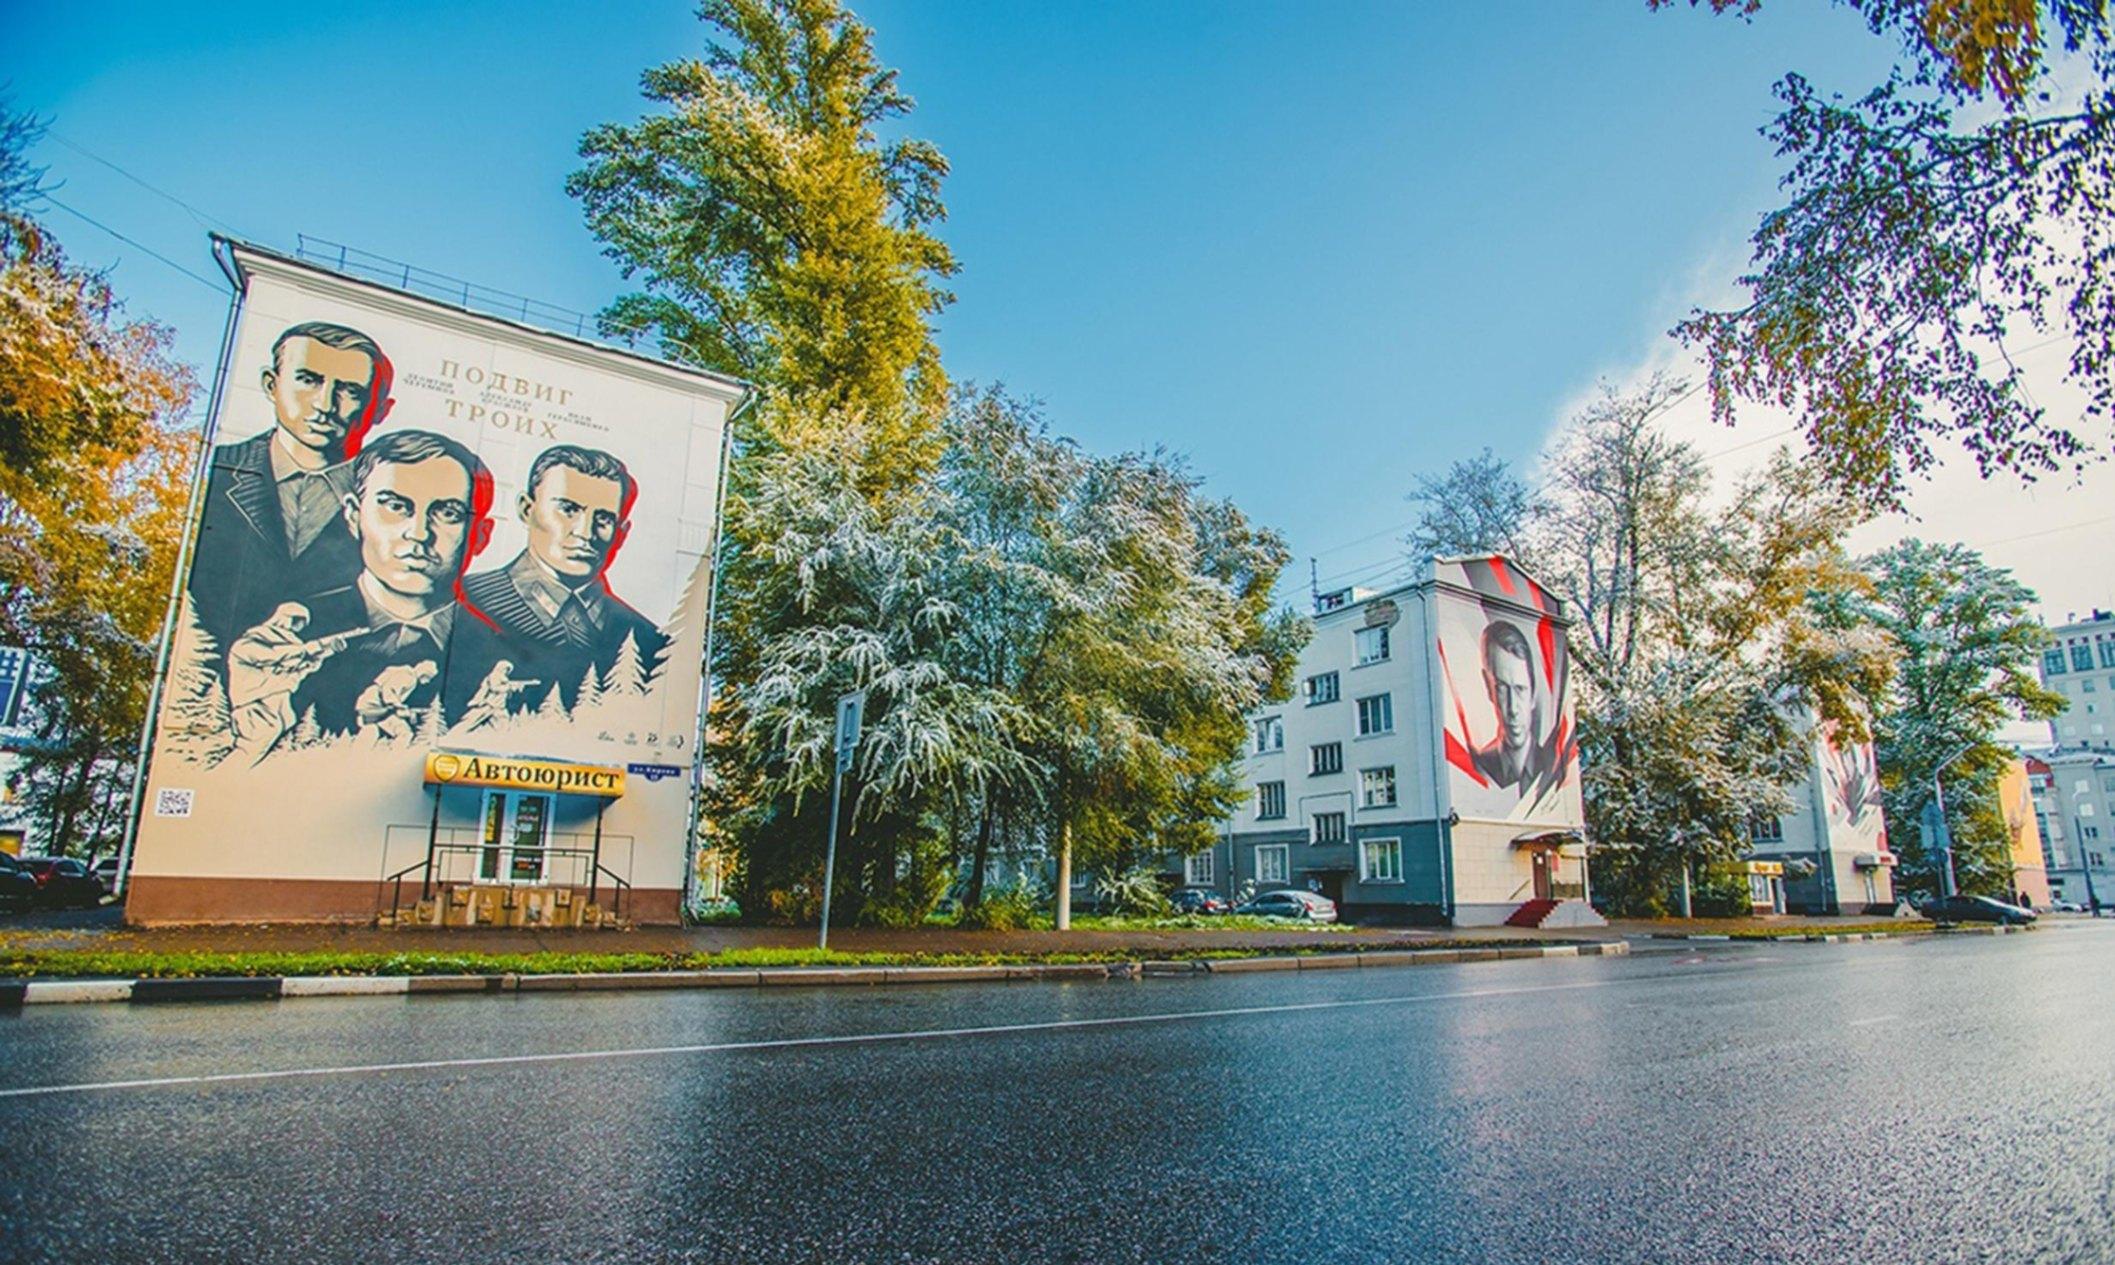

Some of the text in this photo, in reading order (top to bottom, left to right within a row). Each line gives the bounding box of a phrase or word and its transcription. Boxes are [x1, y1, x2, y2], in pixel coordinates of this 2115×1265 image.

[440, 360, 573, 406] ПОДВИГ
[445, 398, 559, 440] ТРОИХ
[463, 757, 620, 790] Автоюрист
